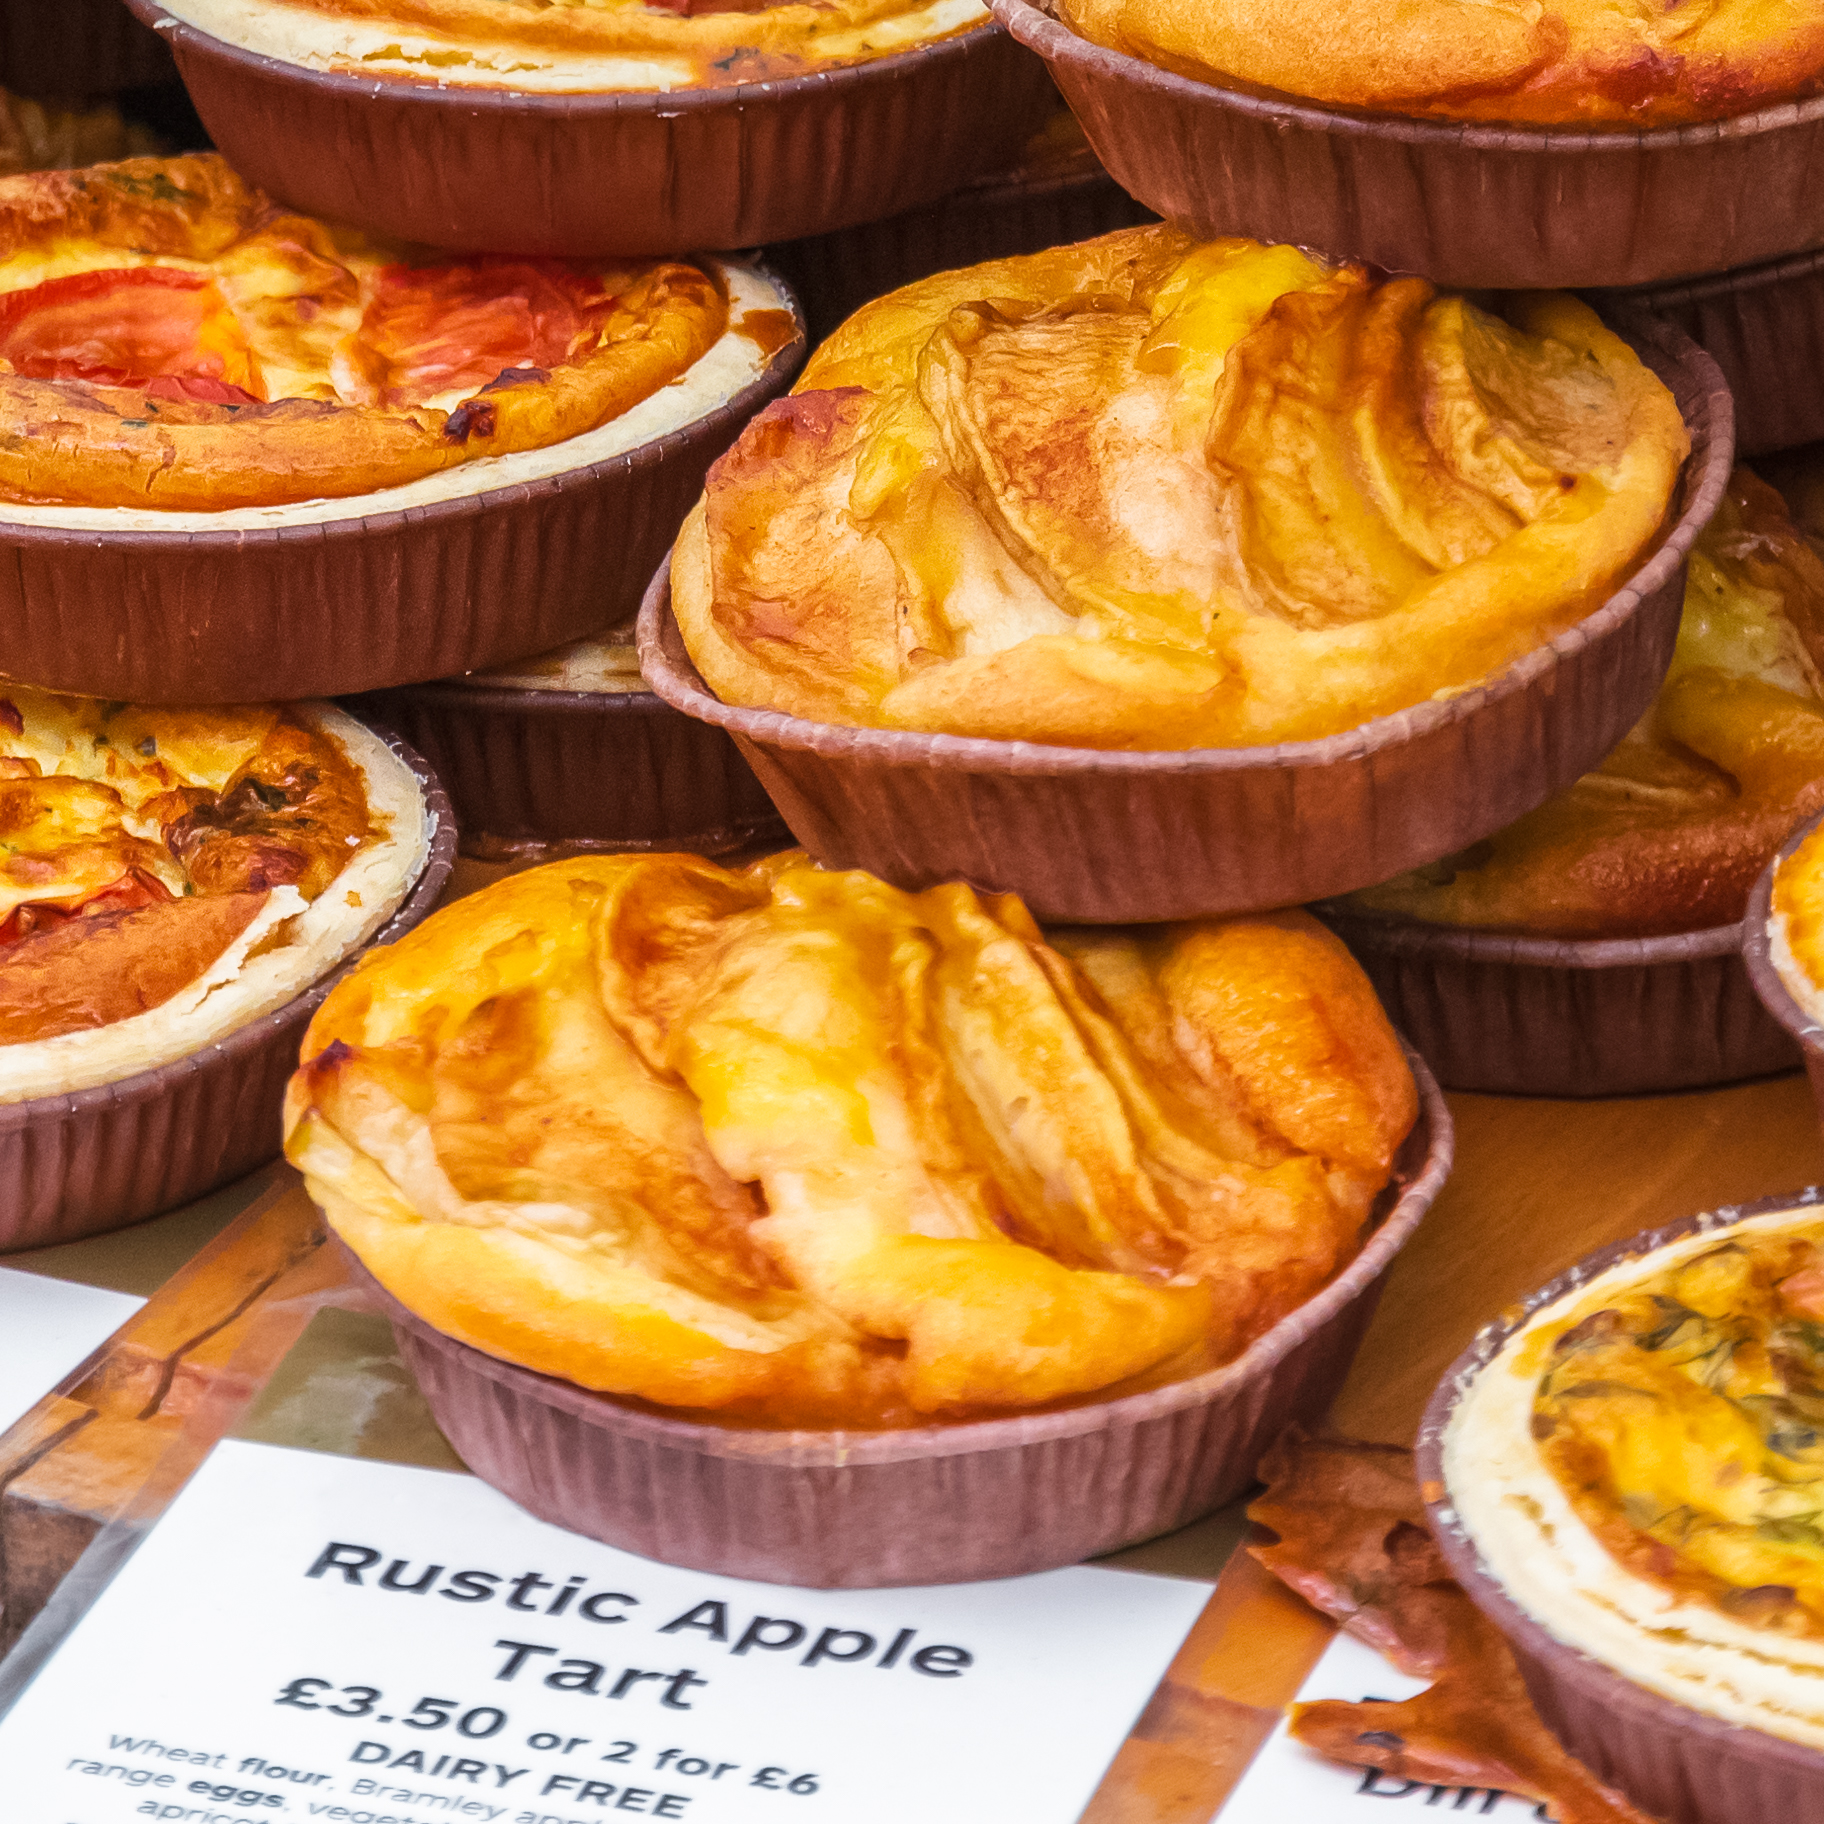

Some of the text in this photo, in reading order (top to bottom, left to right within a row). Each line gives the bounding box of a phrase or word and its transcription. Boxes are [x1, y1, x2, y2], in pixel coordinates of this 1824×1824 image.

[304, 1541, 975, 1678] Rustic Apple
[493, 1639, 709, 1710] Tart
[273, 1677, 820, 1796] £3.50 or 2 for £6
[67, 1759, 176, 1787] range
[187, 1781, 289, 1810] eggs,
[109, 1735, 228, 1768] Wheat
[238, 1757, 333, 1789] flour,
[351, 1779, 507, 1821] Bramley
[348, 1741, 693, 1819] DAIRY FREE
